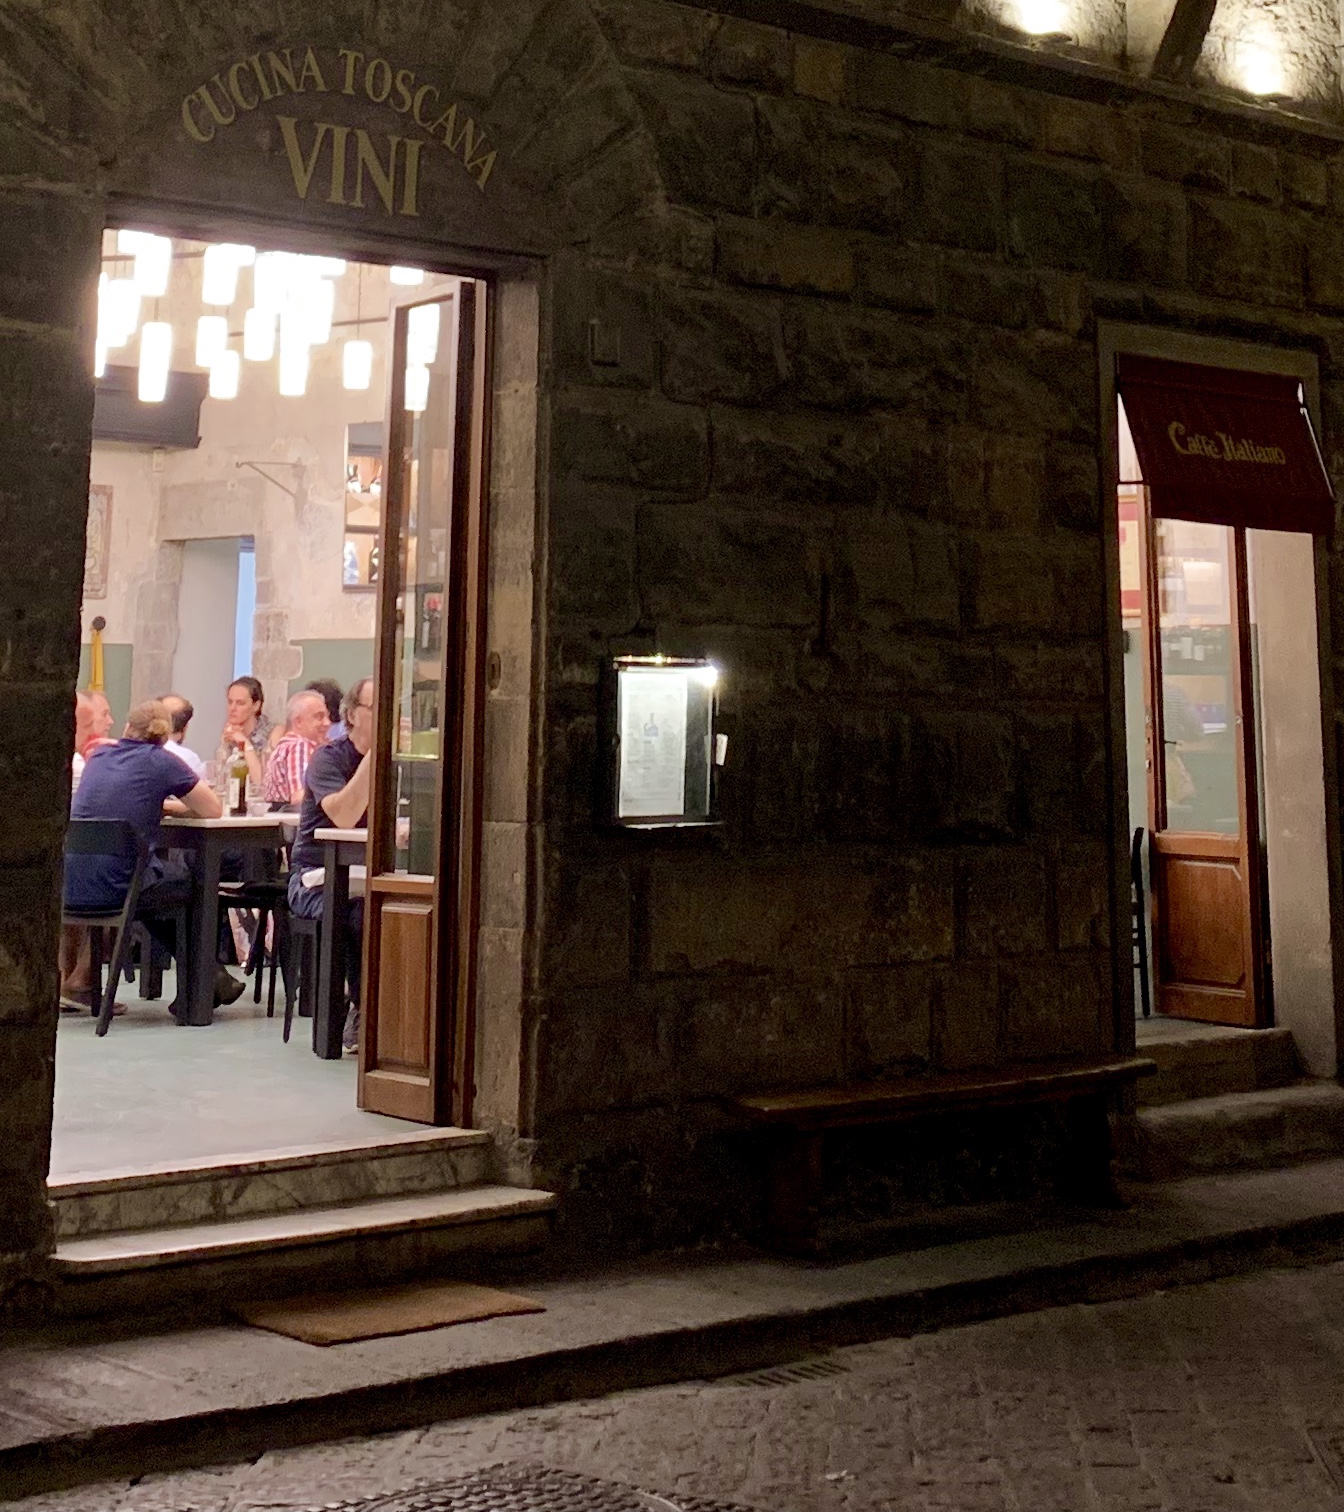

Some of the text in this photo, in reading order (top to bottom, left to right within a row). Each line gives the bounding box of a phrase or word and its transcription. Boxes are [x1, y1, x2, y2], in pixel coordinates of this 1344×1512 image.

[180, 45, 498, 192] CUCINA TOSCANA
[275, 114, 425, 218] VINI
[1215, 430, 1287, 465] Italiano
